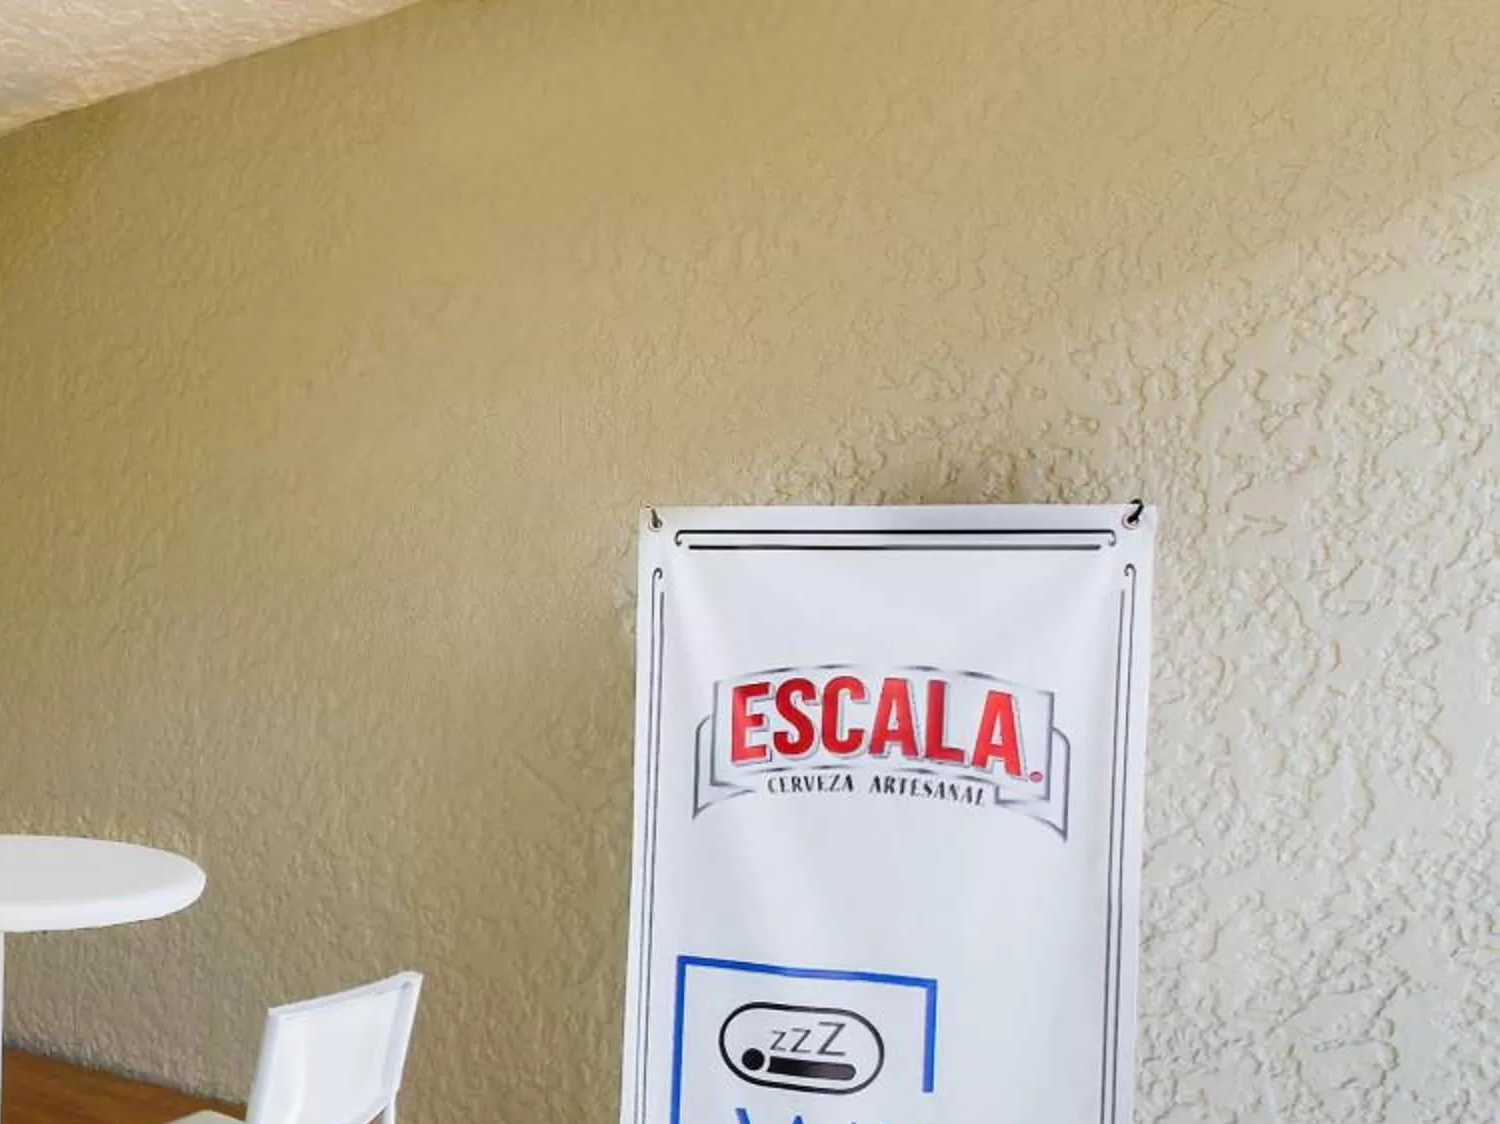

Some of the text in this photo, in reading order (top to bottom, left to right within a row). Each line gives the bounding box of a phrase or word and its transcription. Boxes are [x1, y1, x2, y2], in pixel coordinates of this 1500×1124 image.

[730, 675, 1023, 779] ESCALA
[767, 773, 986, 807] CERVEZA ARTESANAL
